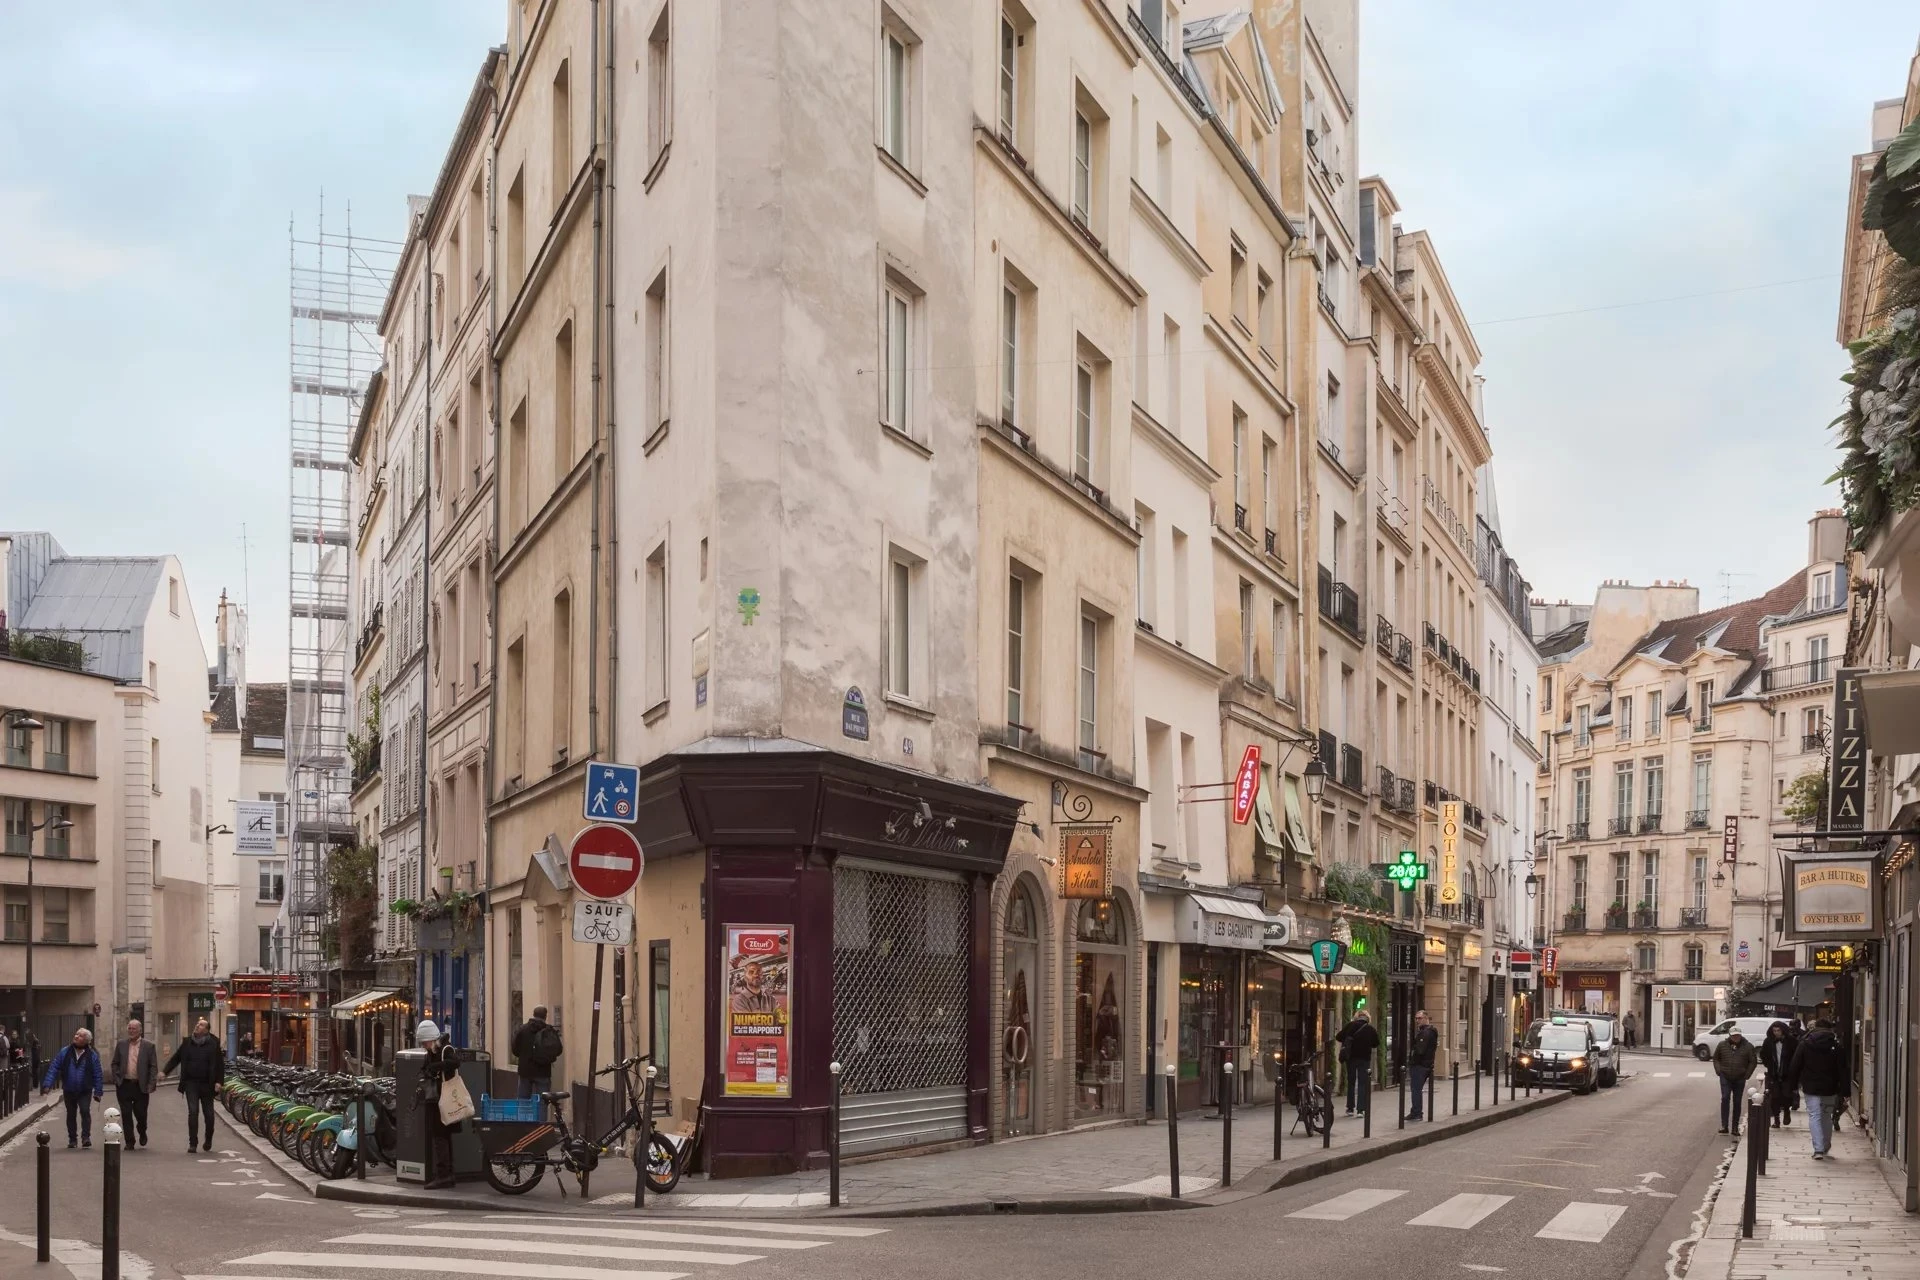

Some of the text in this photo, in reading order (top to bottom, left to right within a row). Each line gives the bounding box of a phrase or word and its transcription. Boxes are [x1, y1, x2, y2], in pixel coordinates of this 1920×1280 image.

[1836, 678, 1859, 817] PIZZA
[1239, 760, 1254, 809] TABAC
[618, 804, 628, 812] 20
[1443, 804, 1456, 884] HÔTEL
[1726, 818, 1736, 861] HOTEL
[1388, 865, 1425, 877] 20/01
[1800, 870, 1867, 886] BAR A HUITRES
[1071, 871, 1099, 888] Kilim
[585, 904, 623, 917] SAUF
[1804, 914, 1862, 924] OYSTER BAR
[1214, 921, 1225, 937] LES
[1228, 923, 1253, 939] GAGNANTS
[749, 940, 769, 948] ZEturf
[1580, 976, 1606, 985] NICOLAS
[748, 1026, 782, 1034] RAPPORTS
